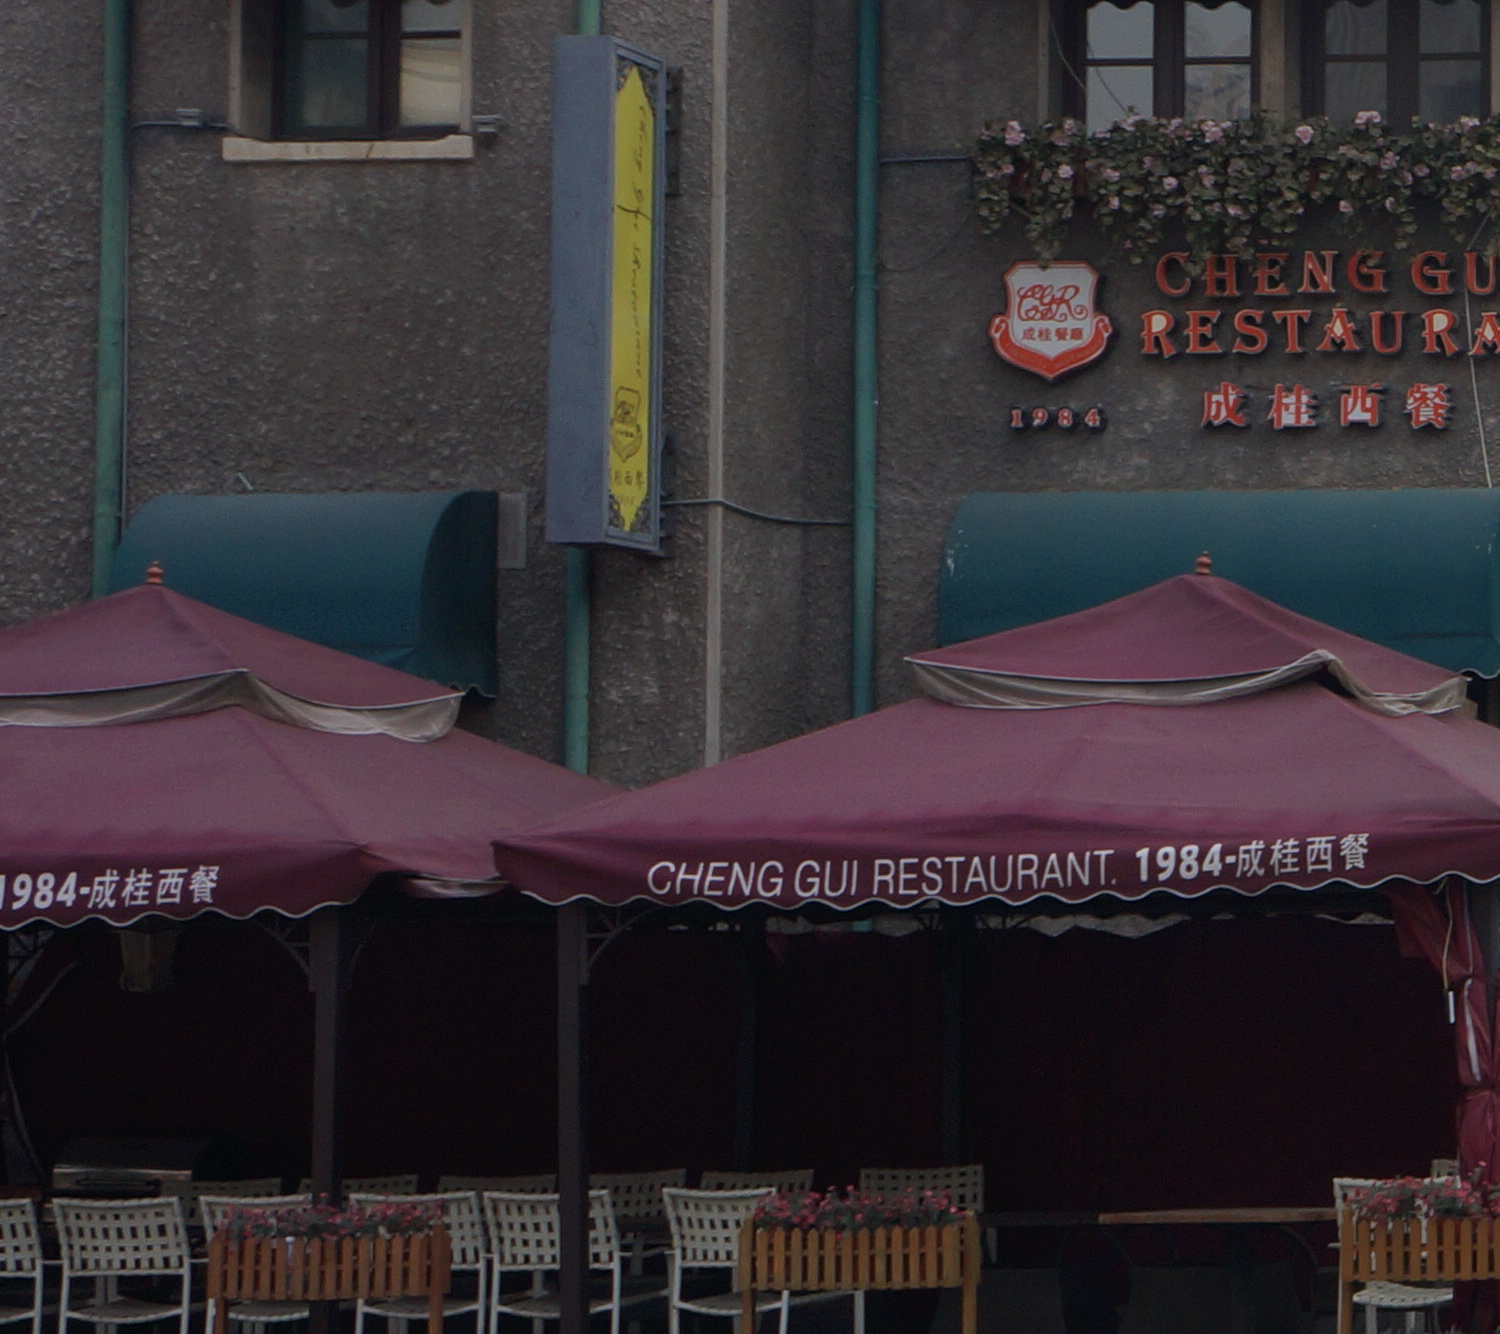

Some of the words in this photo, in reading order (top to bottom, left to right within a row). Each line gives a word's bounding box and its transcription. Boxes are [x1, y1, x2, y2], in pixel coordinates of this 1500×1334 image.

[1155, 250, 1387, 297] CHENG
[1011, 408, 1100, 428] 1984
[1202, 381, 1451, 429] 成桂西餐
[647, 861, 784, 898] CHENG
[795, 860, 858, 898] GUI
